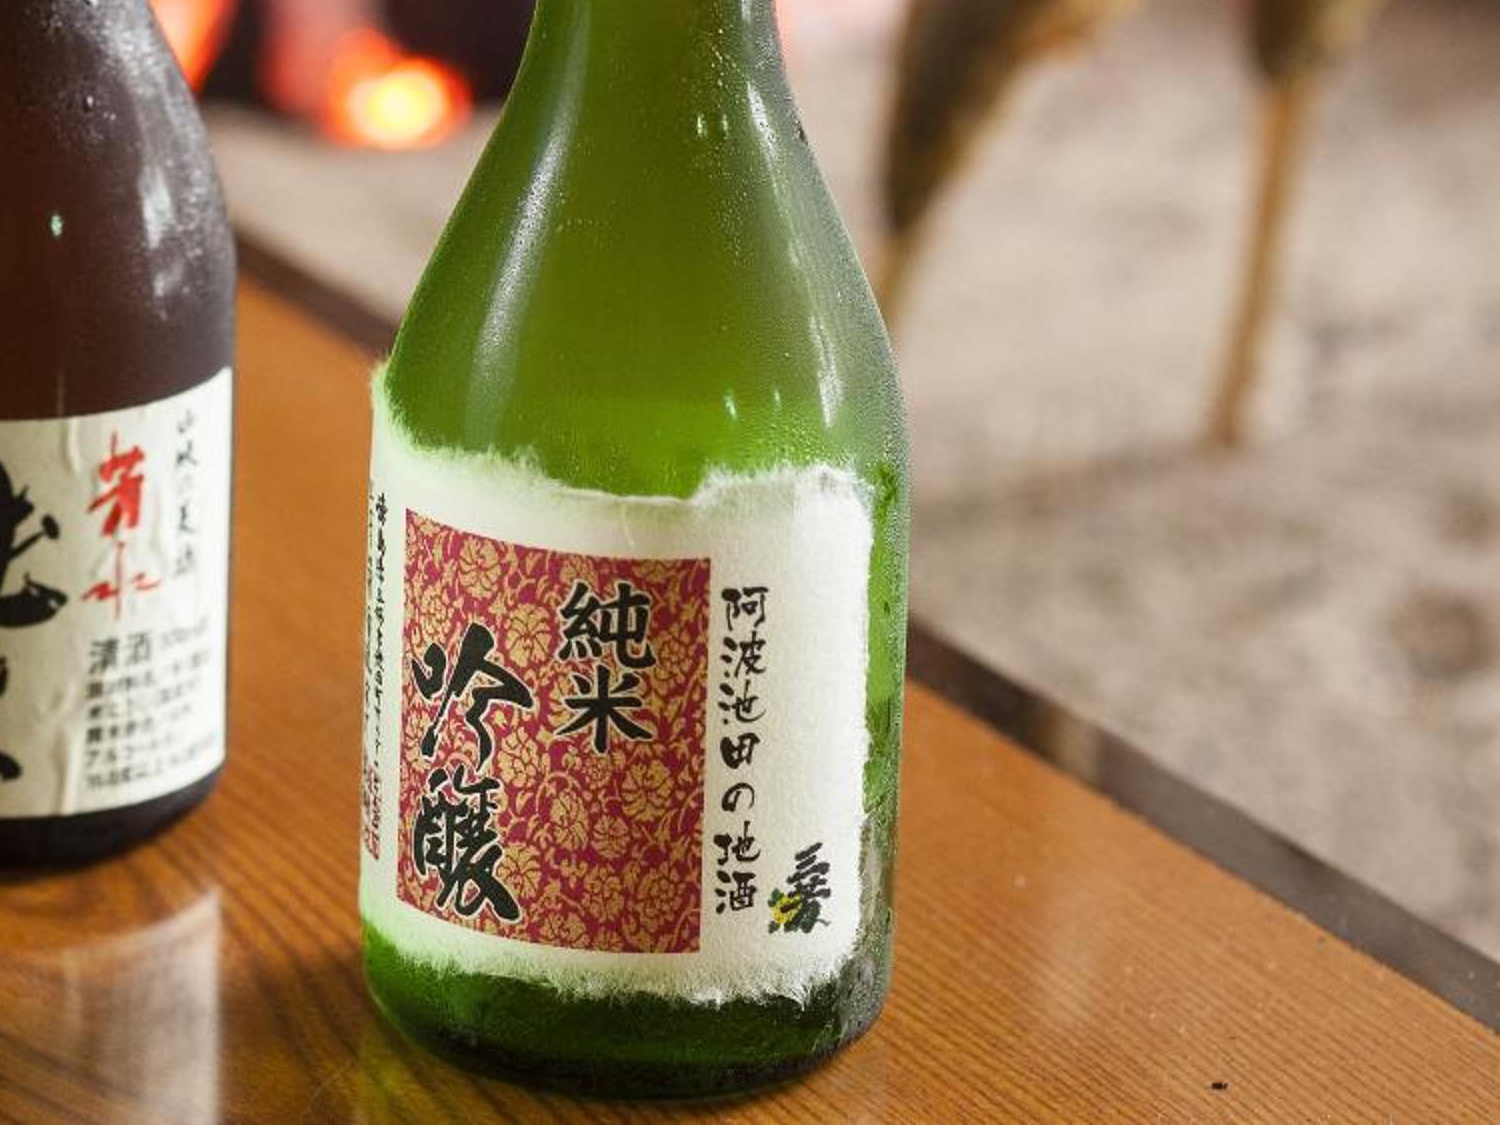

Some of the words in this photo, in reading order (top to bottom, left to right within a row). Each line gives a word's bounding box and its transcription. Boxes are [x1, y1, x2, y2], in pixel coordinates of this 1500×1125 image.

[555, 580, 657, 754] 純米
[713, 585, 769, 915] 阿波池田の地酒
